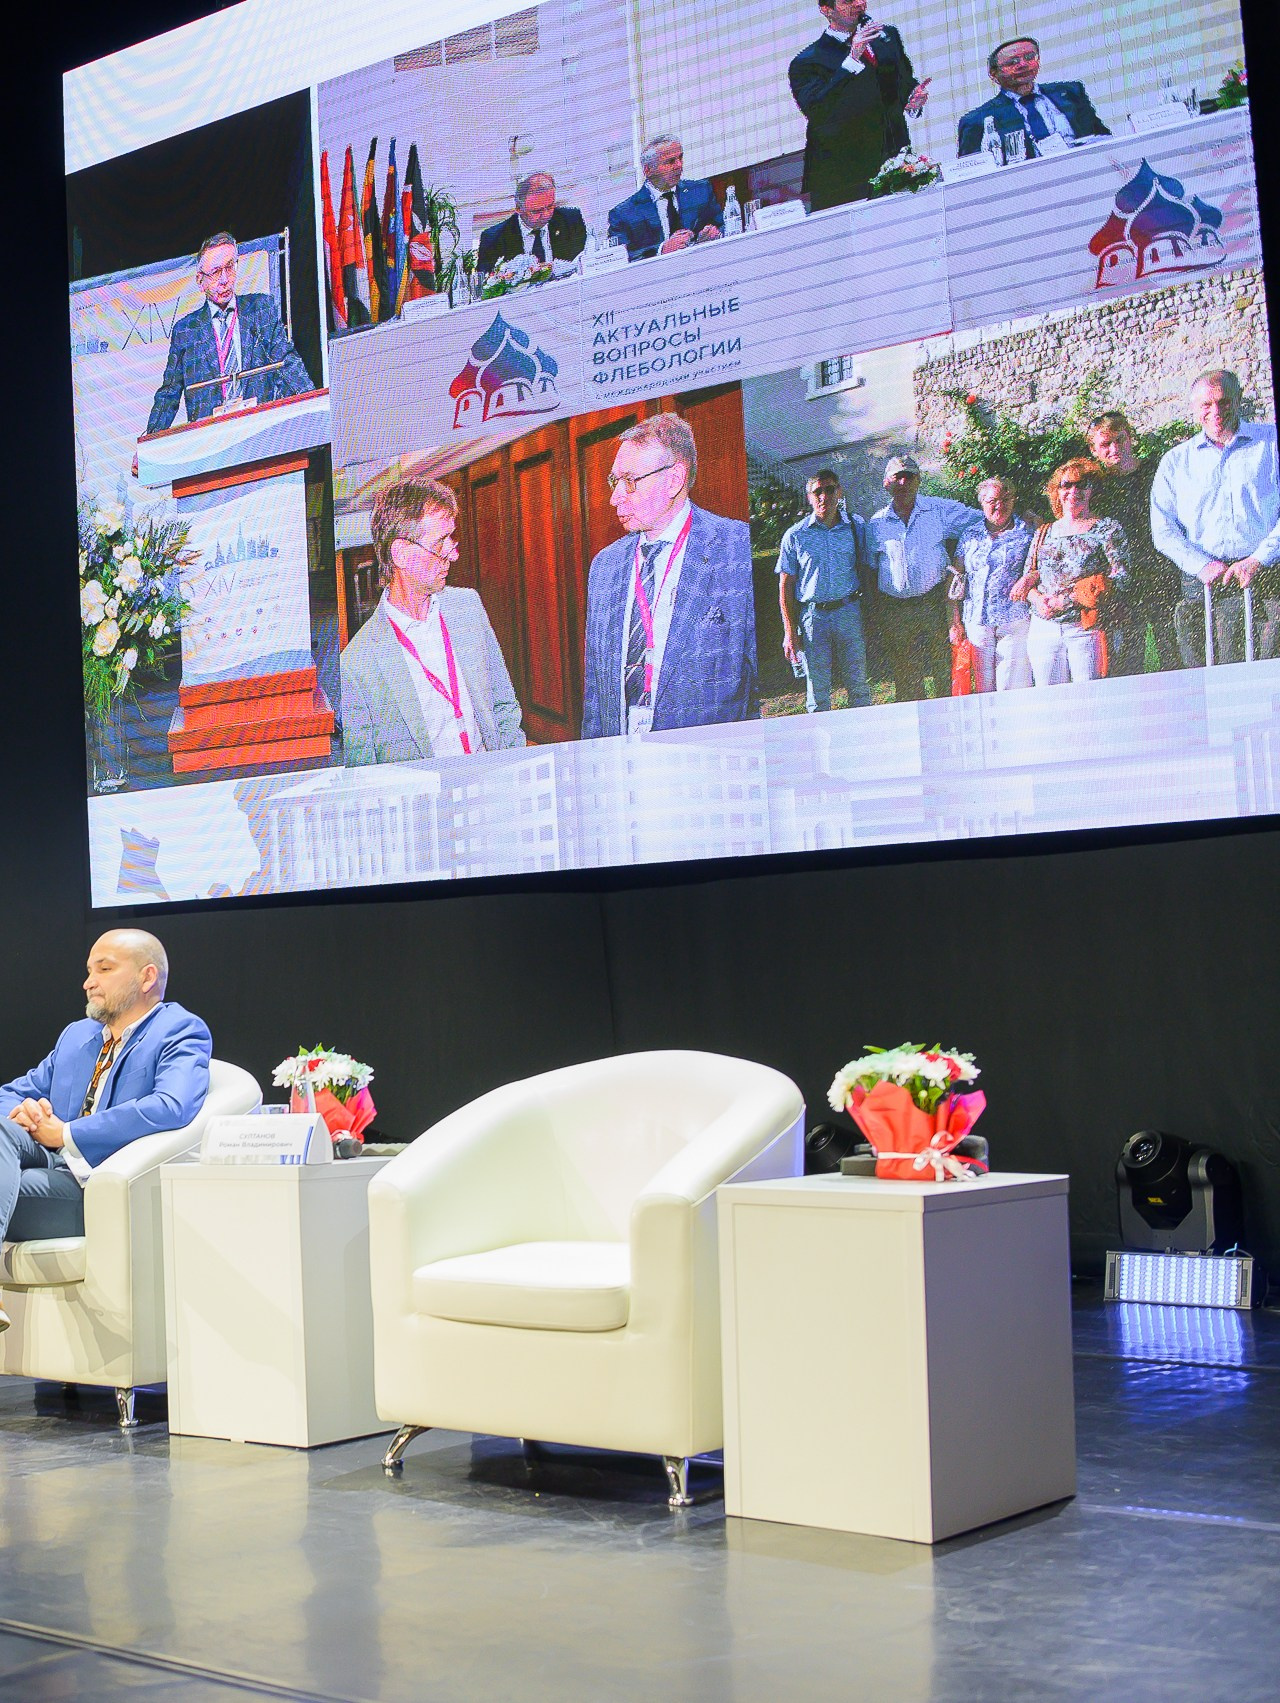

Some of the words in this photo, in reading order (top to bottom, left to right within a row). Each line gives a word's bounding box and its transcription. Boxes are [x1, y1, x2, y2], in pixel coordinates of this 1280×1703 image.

[593, 297, 740, 346] АКТУАЛЬНЫЕ
[593, 327, 701, 365] ВОПРОСЫ
[593, 337, 742, 384] ФЛЕБОЛОГИИ
